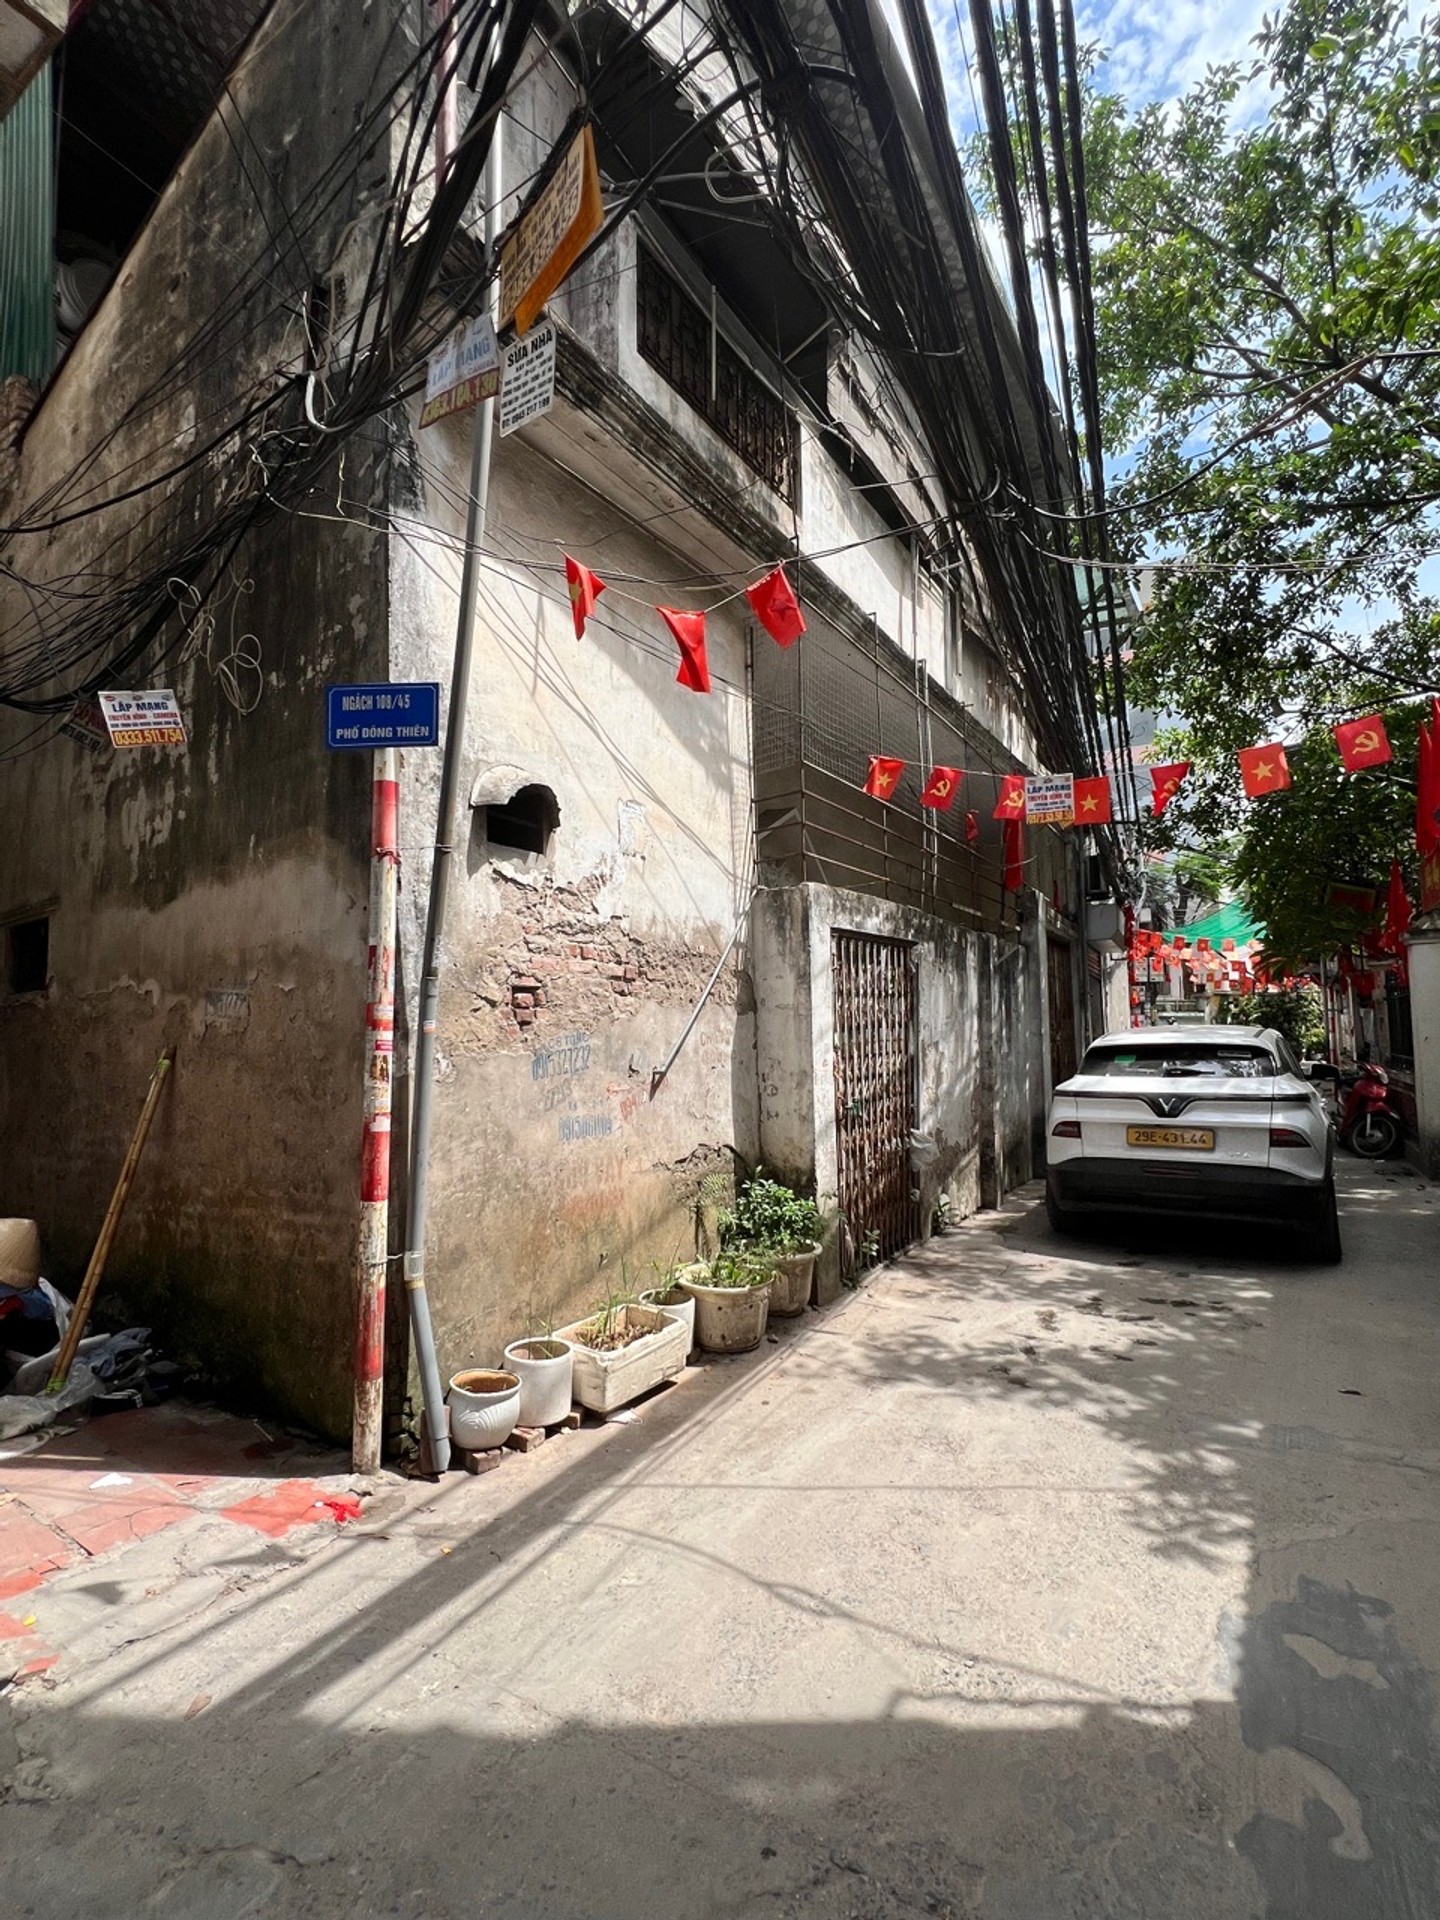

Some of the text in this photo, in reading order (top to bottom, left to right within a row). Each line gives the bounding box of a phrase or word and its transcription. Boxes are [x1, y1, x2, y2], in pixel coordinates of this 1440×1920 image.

[342, 693, 411, 711] NGÁCH 108/45
[336, 723, 430, 739] PHỐ ĐÔNG THIÊN
